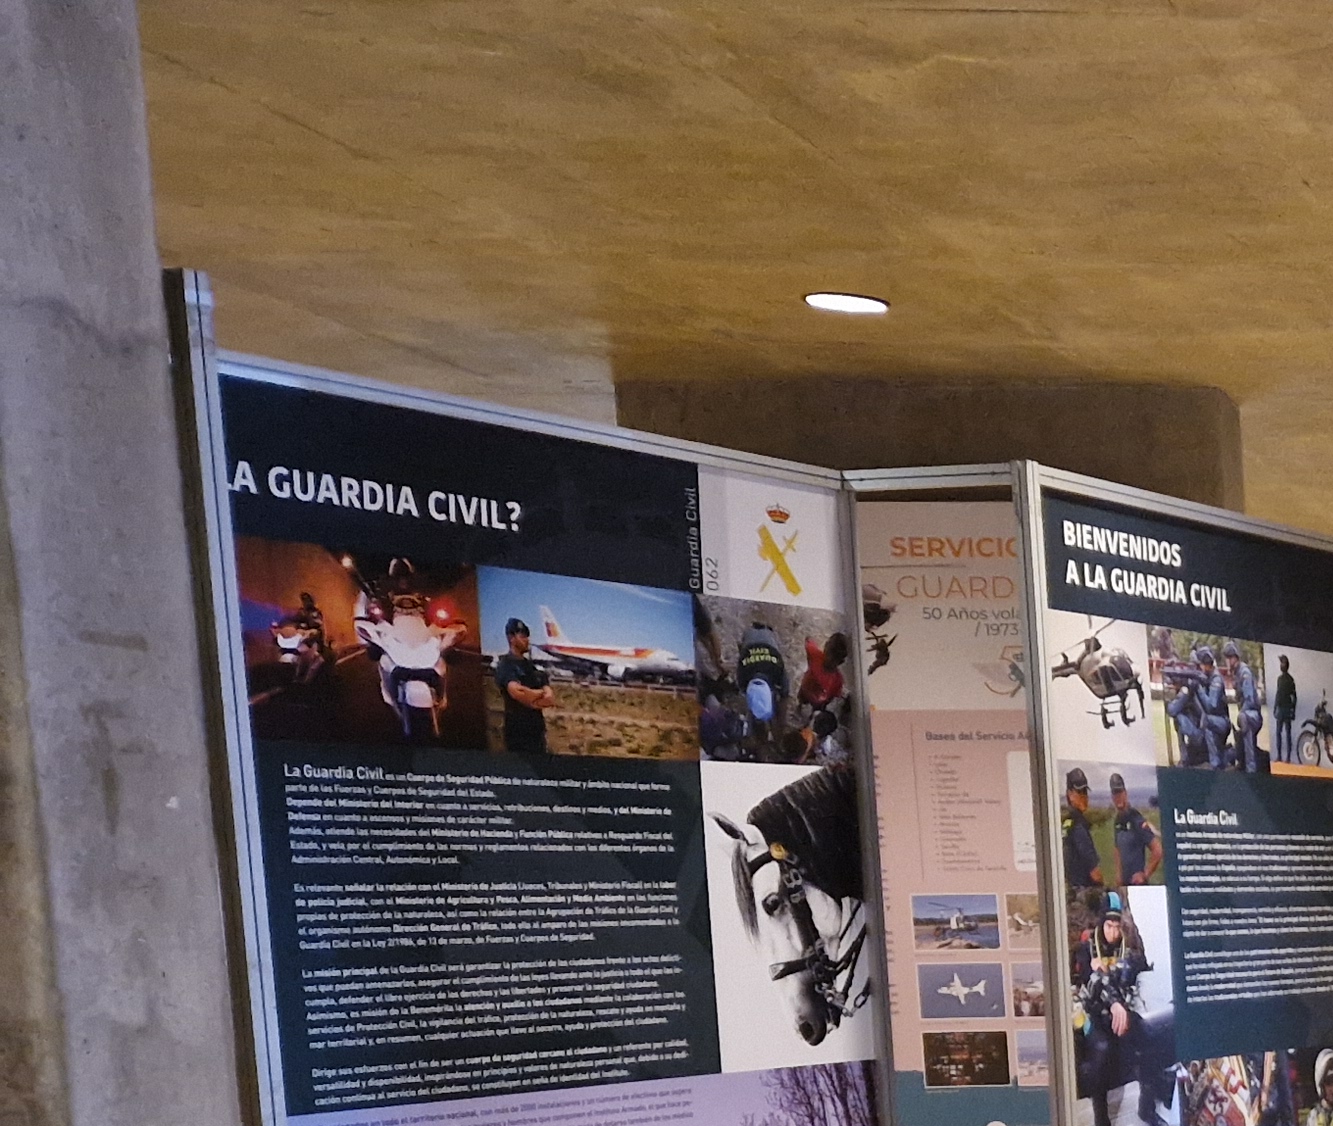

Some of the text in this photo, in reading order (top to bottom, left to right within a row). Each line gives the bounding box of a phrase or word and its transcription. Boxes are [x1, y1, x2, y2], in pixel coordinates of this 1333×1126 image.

[228, 460, 521, 532] A GUARDIA CIVIL?
[686, 487, 700, 589] Guardia Civil
[1062, 519, 1182, 568] BIENVENIDOS
[706, 557, 719, 591] 062
[1065, 559, 1232, 613] A LA GUARDIA CIVIL
[922, 606, 942, 620] 50
[946, 606, 988, 621] Años
[284, 764, 300, 777] La
[303, 764, 353, 780] Guardia
[356, 766, 384, 780] Civil
[1174, 808, 1238, 825] La Guardia Civil
